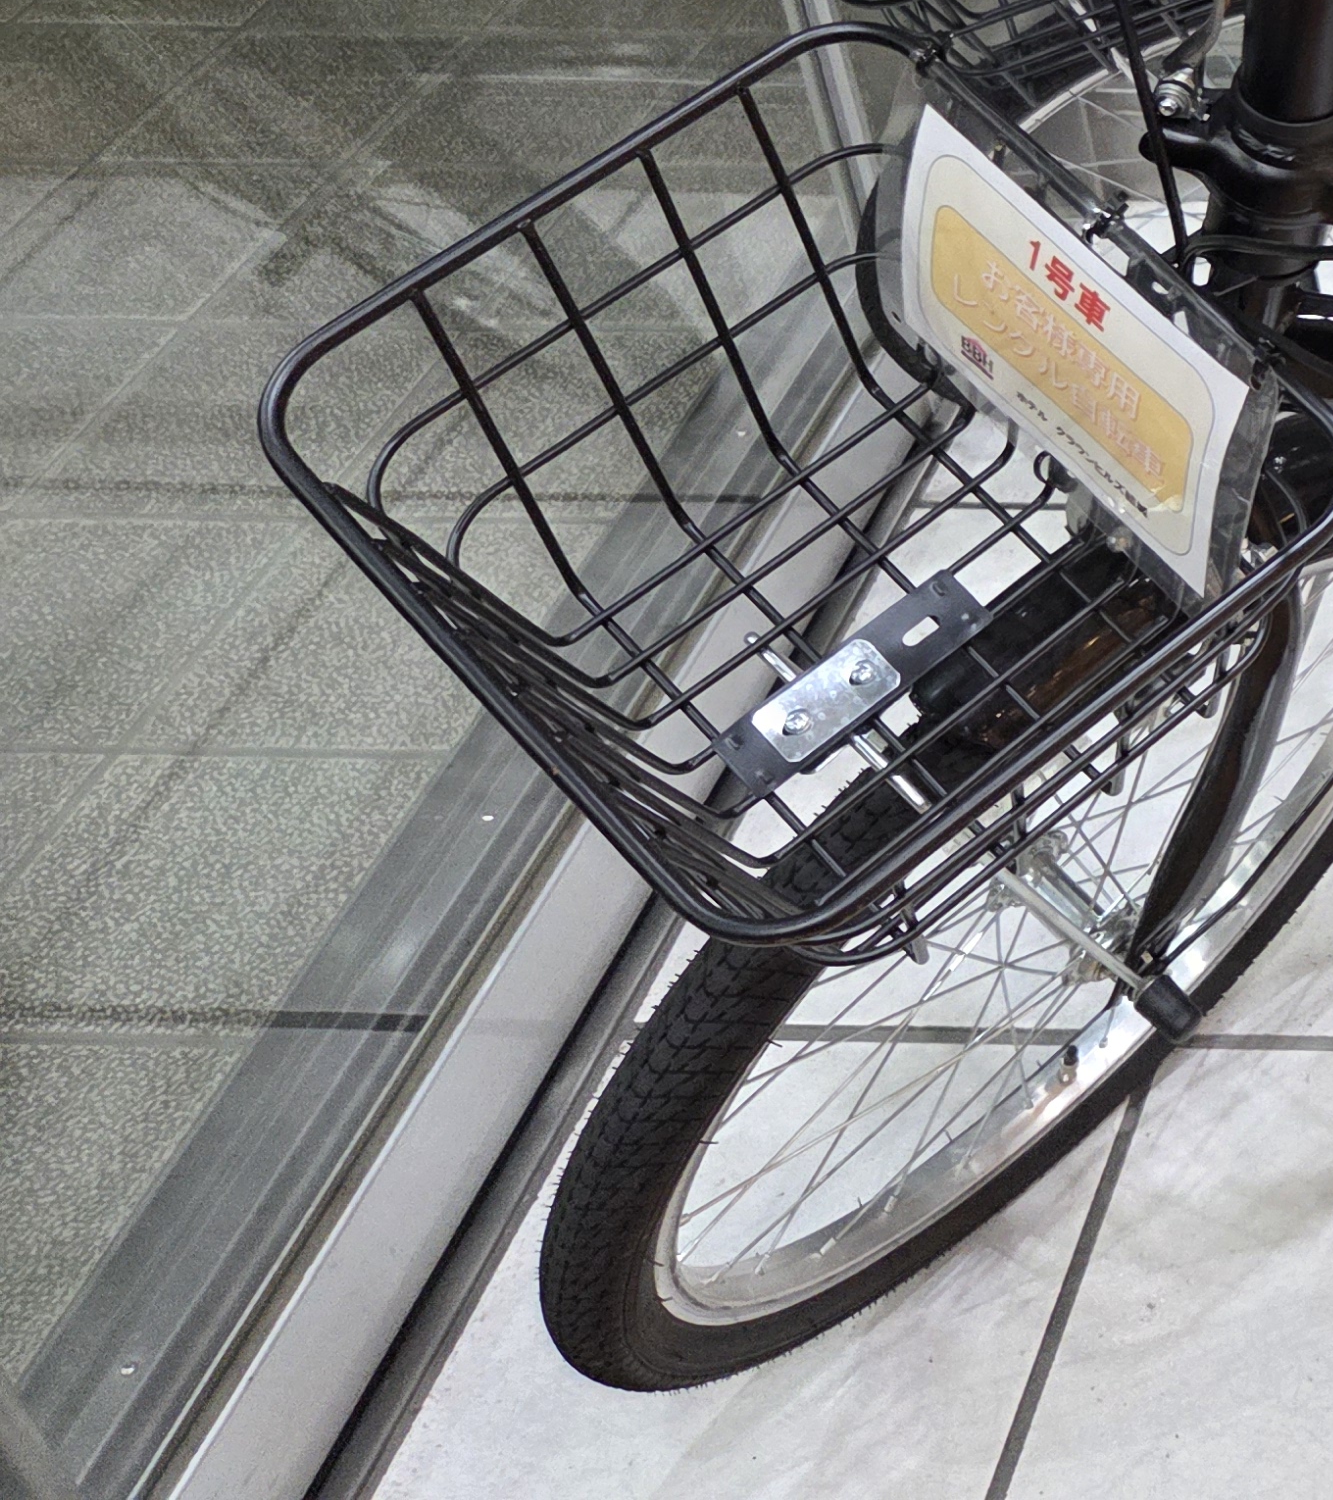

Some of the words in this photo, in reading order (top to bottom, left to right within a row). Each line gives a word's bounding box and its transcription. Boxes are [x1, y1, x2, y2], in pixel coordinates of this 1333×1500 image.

[1026, 239, 1111, 332] 1号車
[961, 336, 994, 374] BBH
[980, 260, 1141, 420] お客様専用
